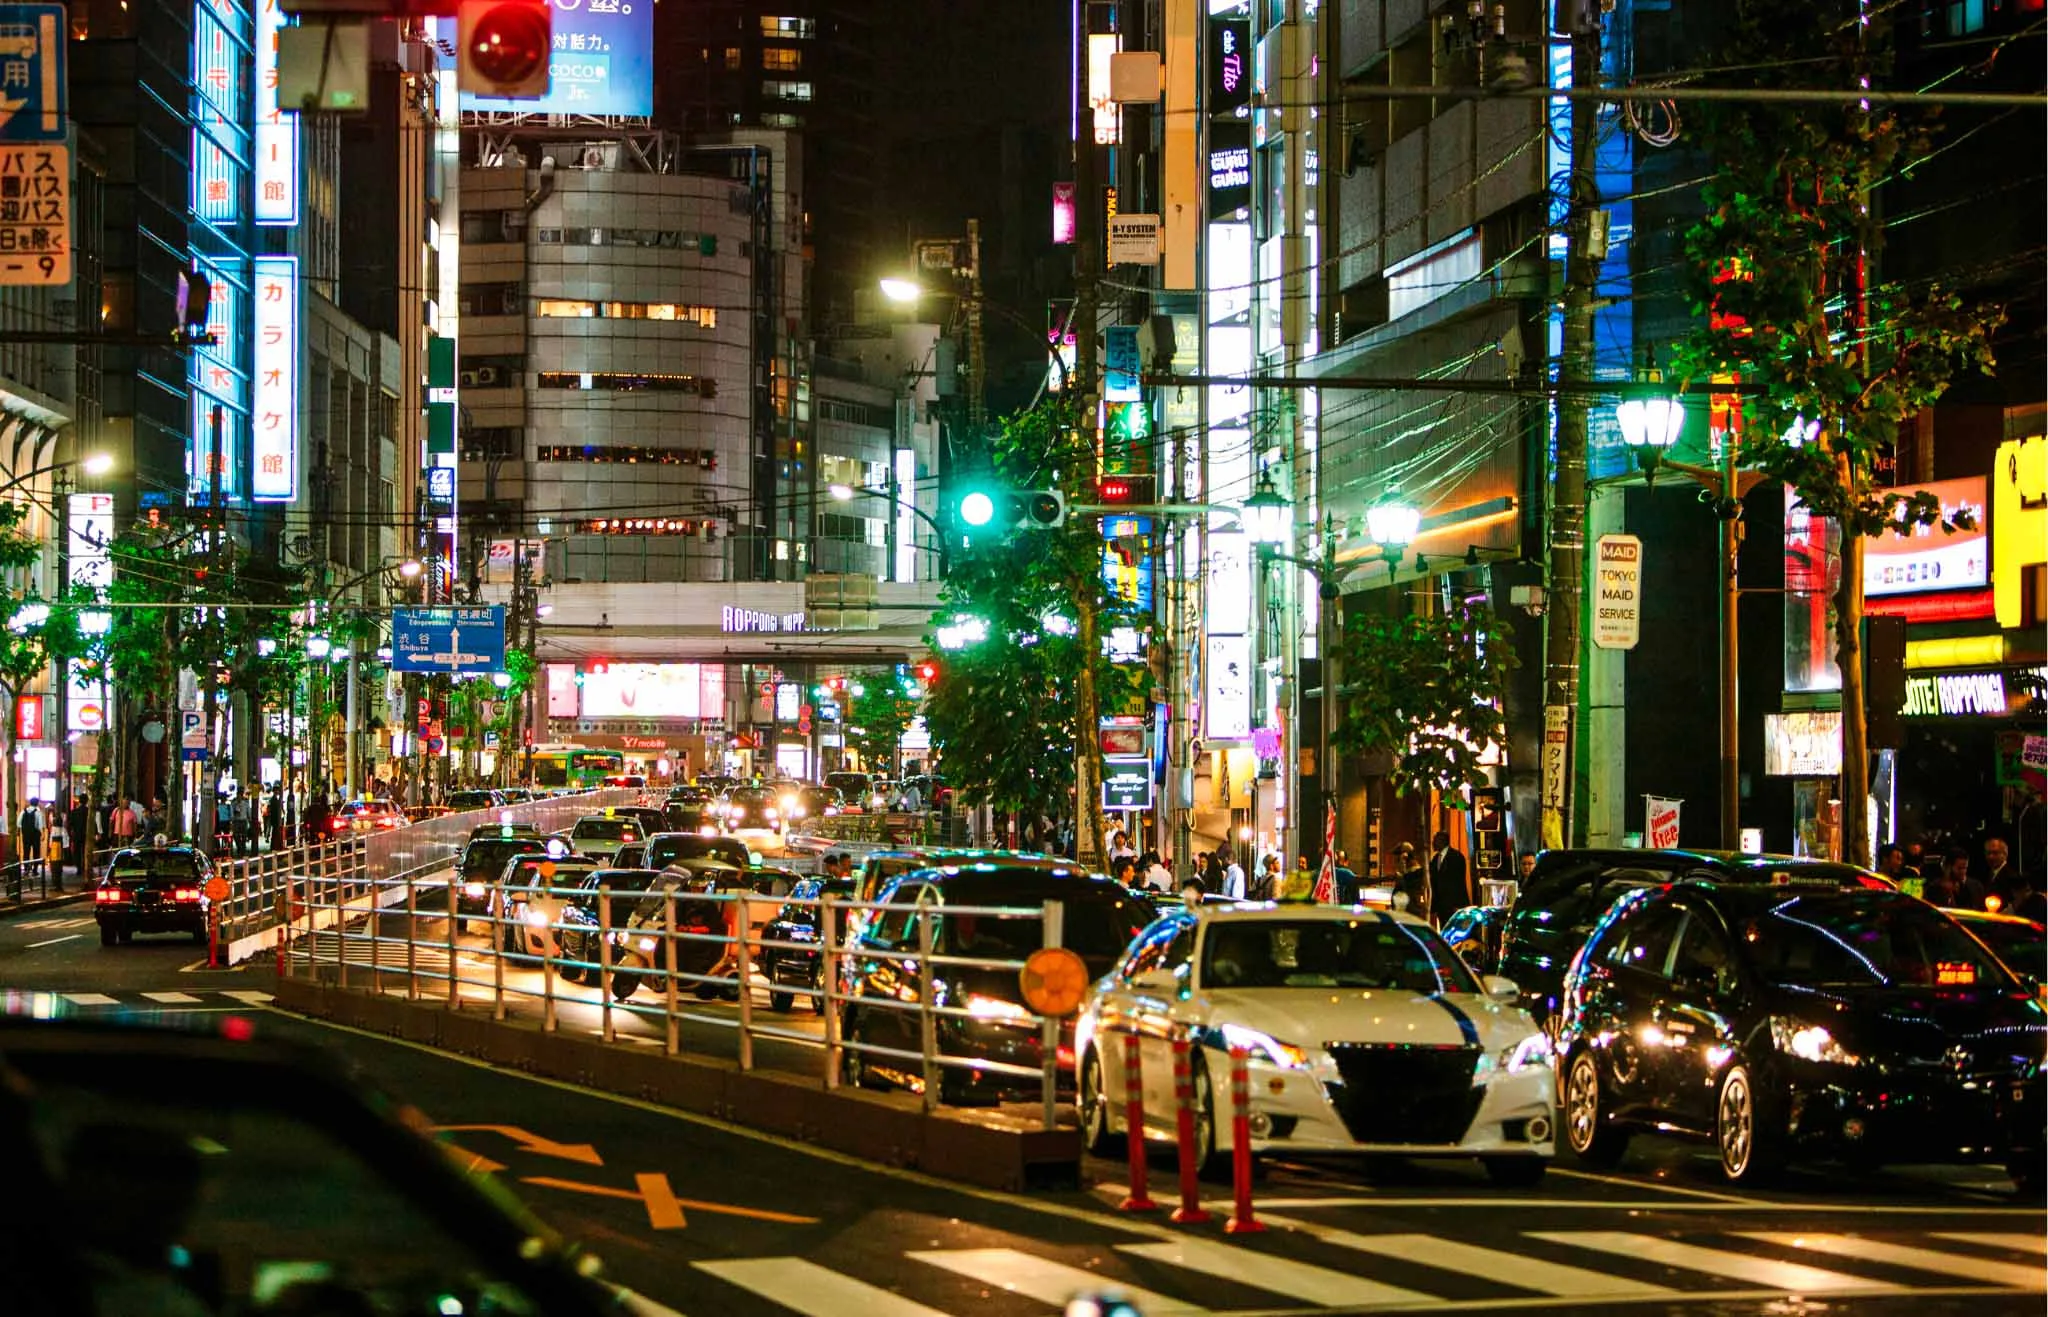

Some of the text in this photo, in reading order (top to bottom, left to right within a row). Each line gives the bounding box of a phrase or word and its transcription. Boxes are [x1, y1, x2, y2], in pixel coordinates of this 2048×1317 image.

[553, 33, 610, 50] 対話力。
[1224, 30, 1235, 54] club
[263, 283, 283, 474] カラオケ館
[1603, 546, 1636, 558] MAID
[1600, 570, 1636, 581] TOKYO
[1602, 589, 1633, 600] MAID
[722, 606, 777, 631] ROPPONGI
[1600, 608, 1635, 619] SERVICE
[1549, 746, 1561, 809] タマリヤ
[1652, 825, 1678, 848] Free
